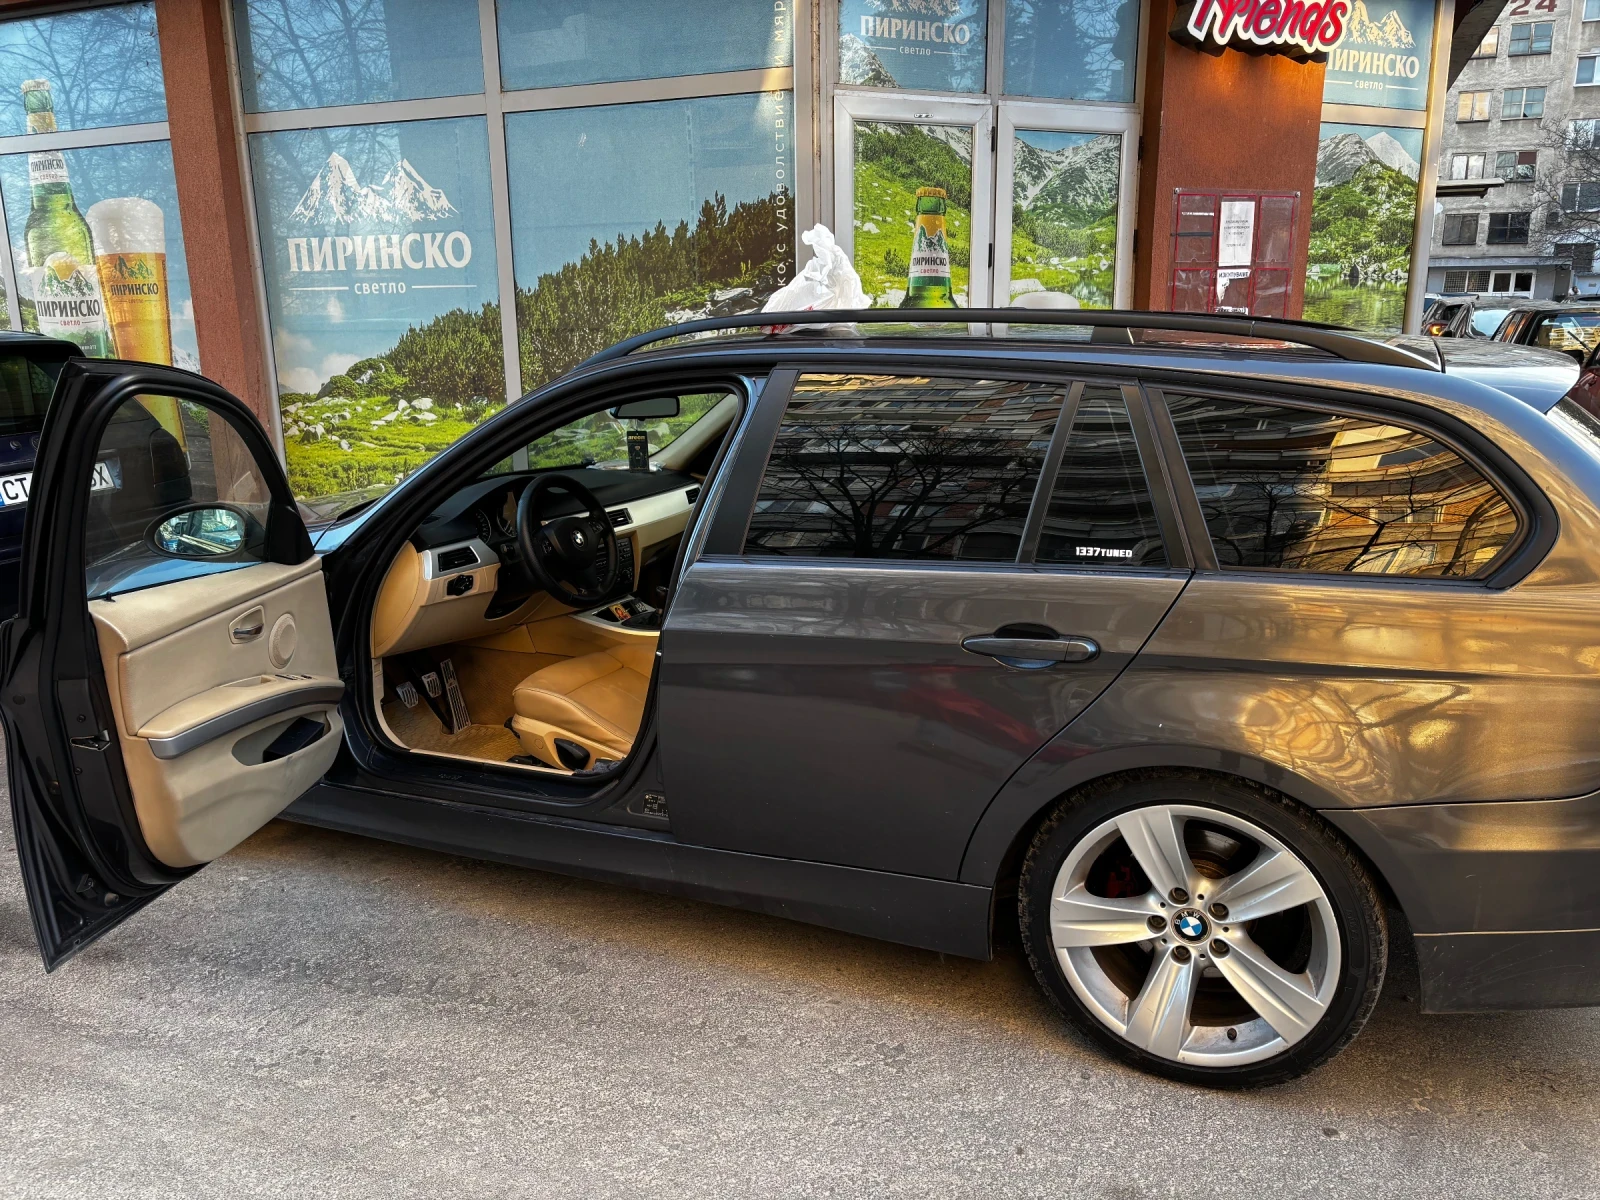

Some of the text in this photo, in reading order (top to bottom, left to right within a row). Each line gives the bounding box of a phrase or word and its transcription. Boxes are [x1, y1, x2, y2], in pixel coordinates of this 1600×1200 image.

[1509, 0, 1557, 17] 24
[860, 15, 971, 45] ПИРИНСКО
[899, 46, 931, 56] светло
[1354, 80, 1384, 90] светло
[31, 158, 64, 172] ПИРИНСКО
[286, 231, 472, 272] ПИРИНСКО
[912, 256, 947, 266] ПИРИНСКО
[110, 283, 159, 296] ПИРИНСКО
[354, 281, 407, 295] светло
[36, 299, 100, 317] ПИРИНСКО
[1075, 546, 1133, 558] 1337TUNED
[1174, 911, 1200, 926] BMW
